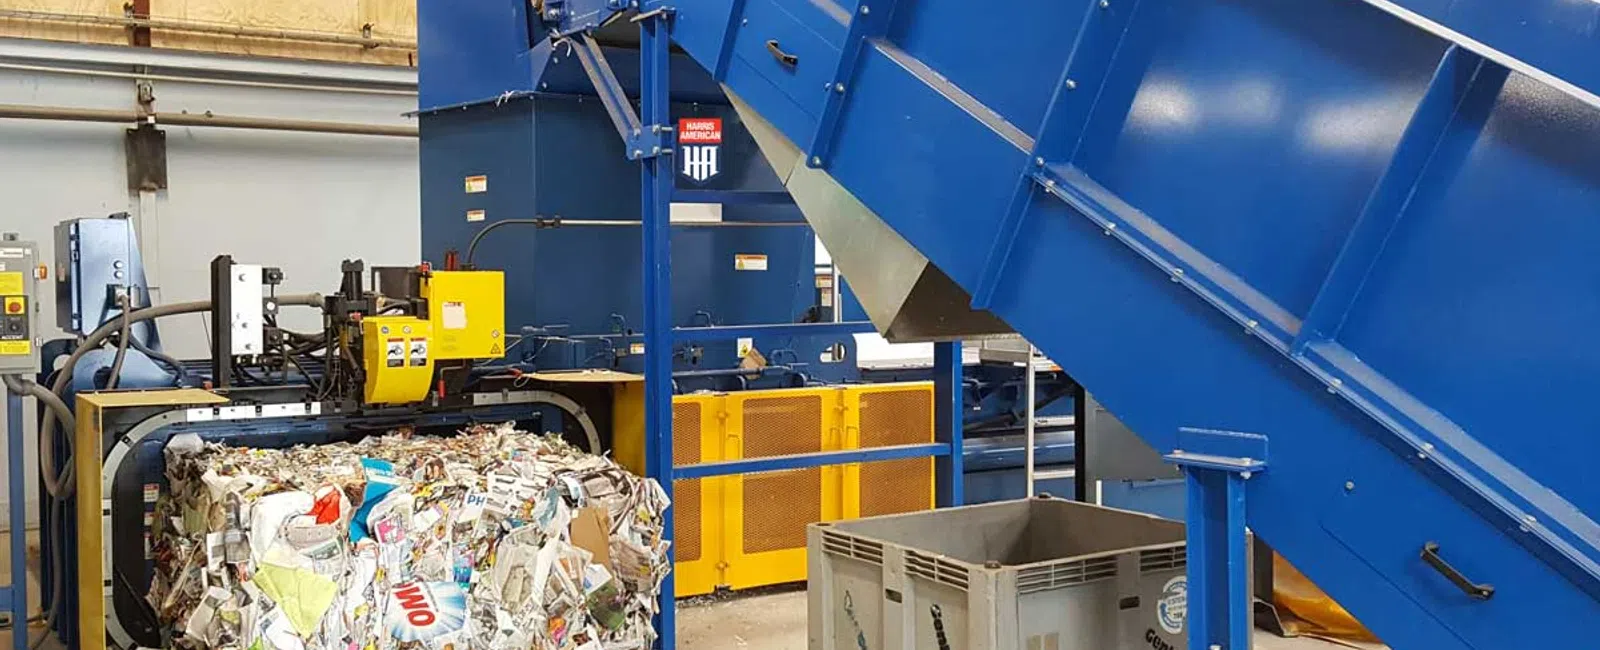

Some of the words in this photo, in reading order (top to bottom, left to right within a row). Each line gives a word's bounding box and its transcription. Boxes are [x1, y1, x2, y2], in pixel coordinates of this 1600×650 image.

[686, 122, 715, 131] HARRIS
[680, 131, 721, 140] AMERICAN
[1145, 628, 1175, 650] Gen
